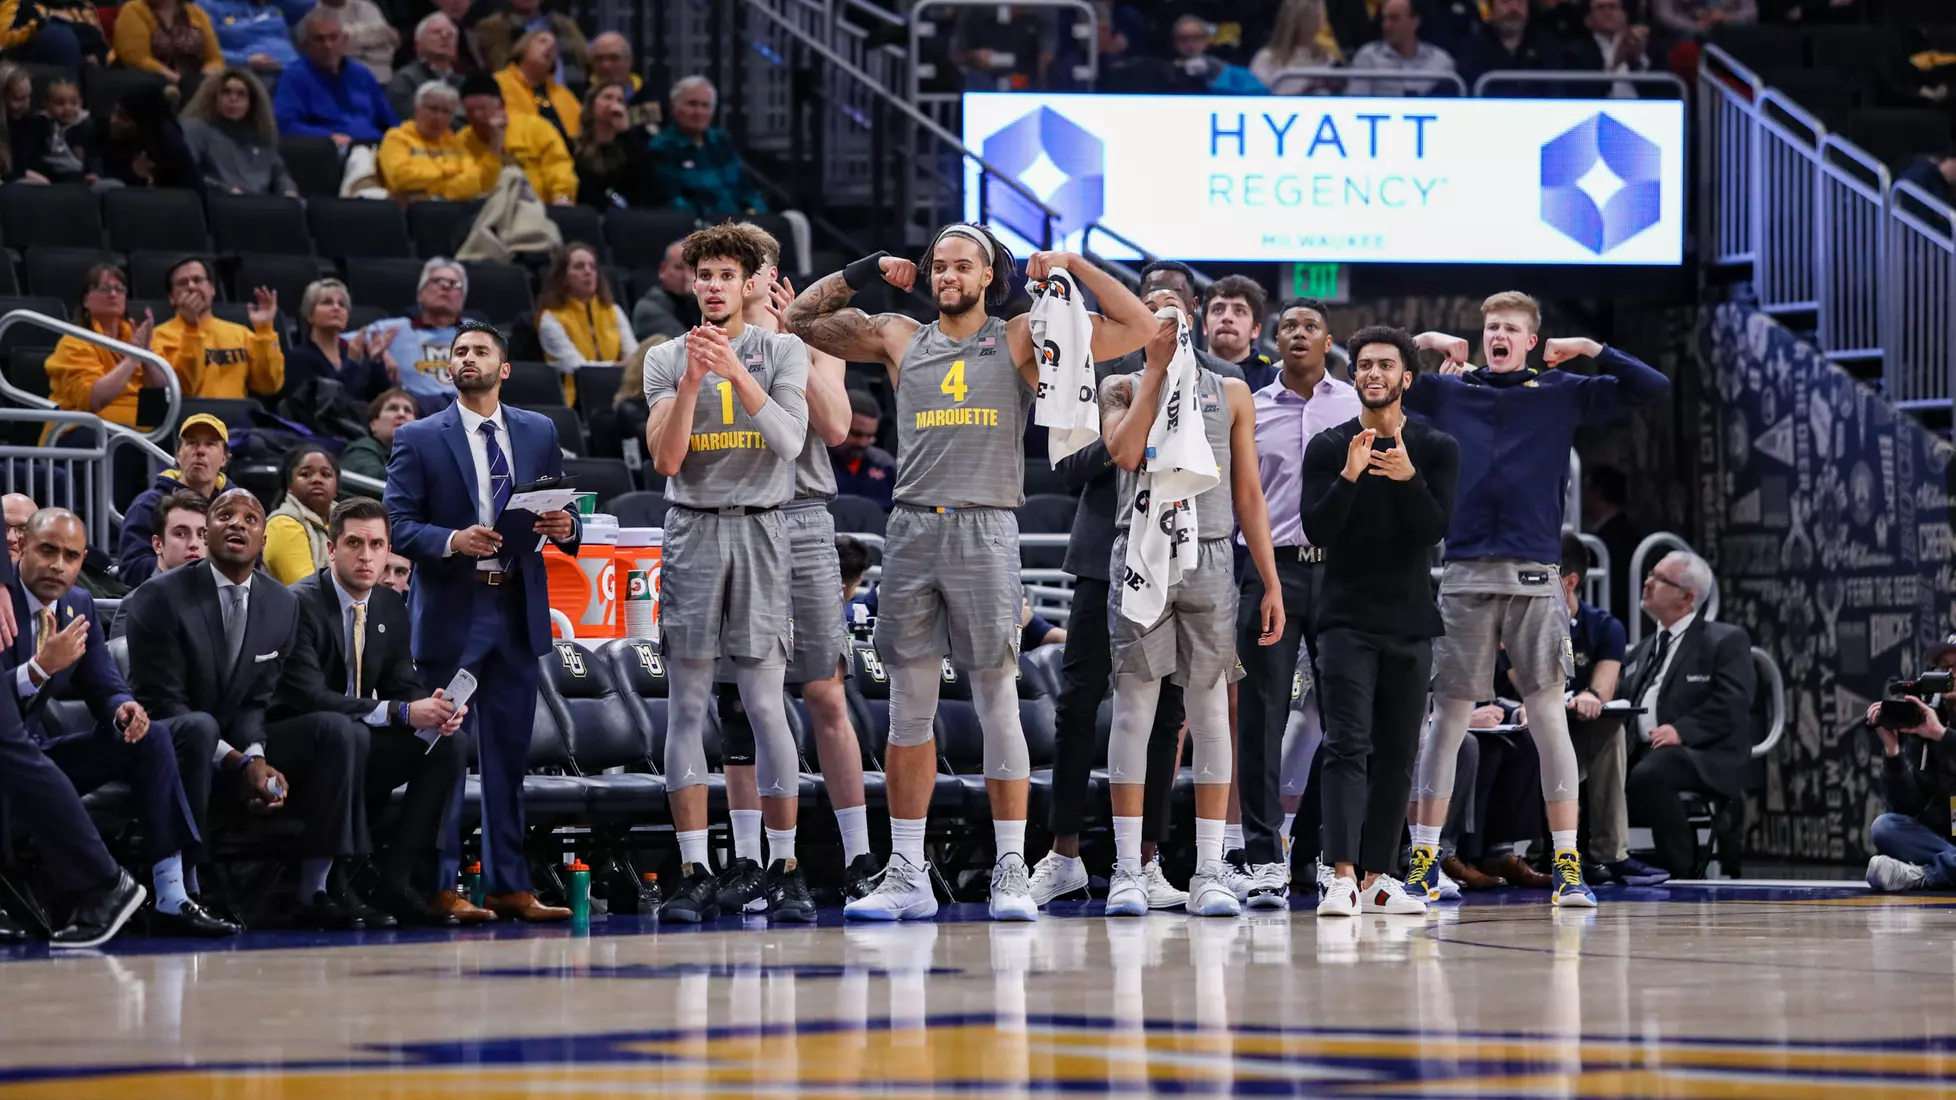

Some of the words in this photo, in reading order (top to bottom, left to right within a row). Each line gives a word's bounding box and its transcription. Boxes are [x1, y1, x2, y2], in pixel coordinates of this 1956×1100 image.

[1210, 112, 1438, 159] HYATT
[1209, 174, 1438, 207] REGENCY
[1261, 233, 1385, 249] MILWAUKEE
[1293, 262, 1338, 298] EXIT
[940, 360, 968, 402] 4
[716, 381, 734, 425] 1
[916, 408, 998, 429] MARQUETTE
[554, 641, 588, 678] MU
[630, 643, 665, 678] MU
[857, 648, 888, 683] MU
